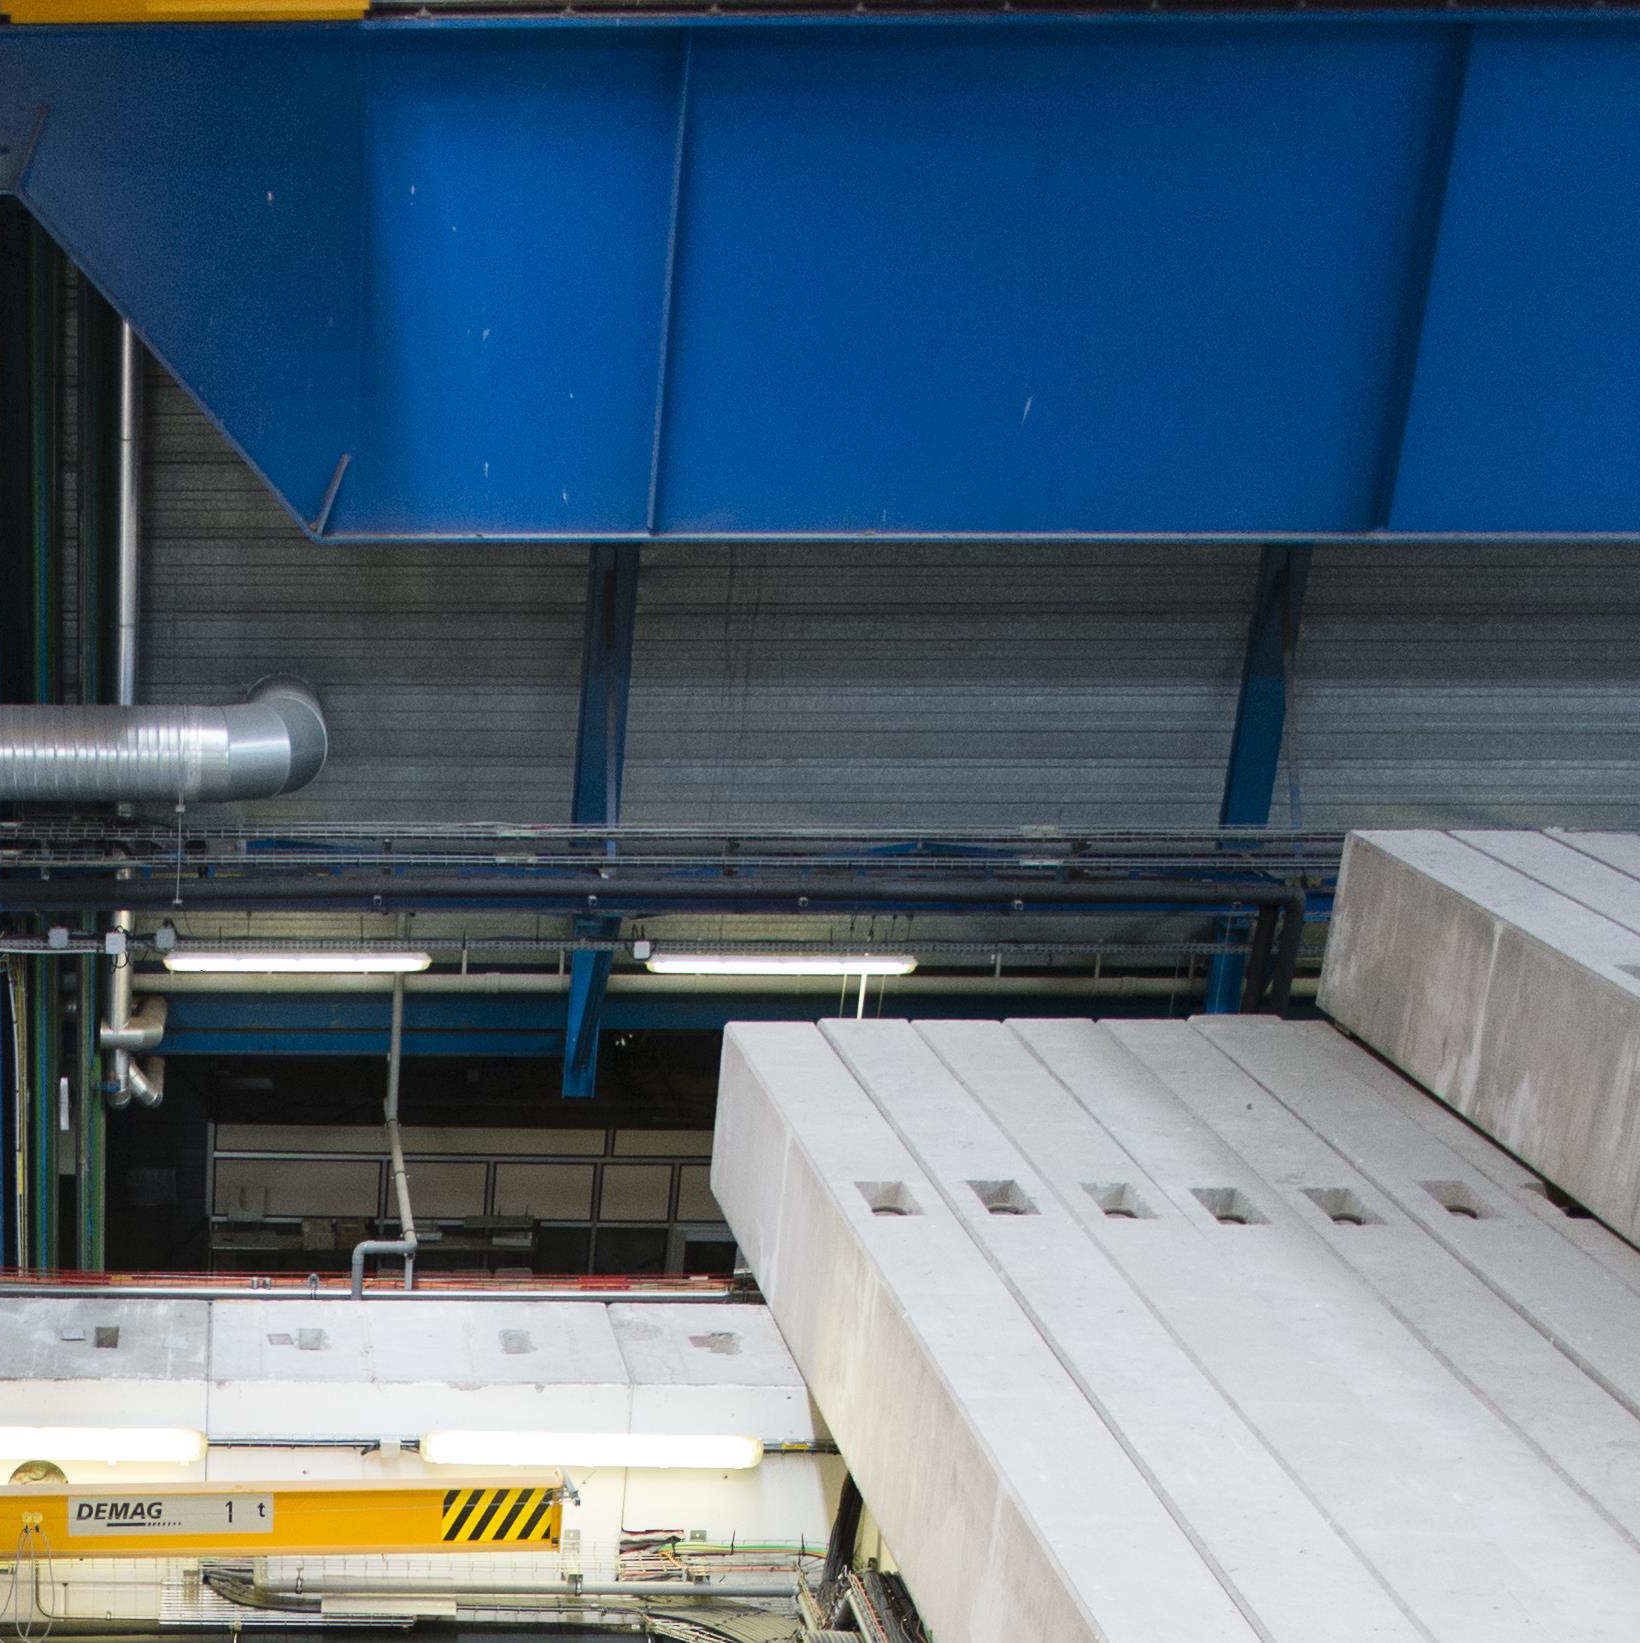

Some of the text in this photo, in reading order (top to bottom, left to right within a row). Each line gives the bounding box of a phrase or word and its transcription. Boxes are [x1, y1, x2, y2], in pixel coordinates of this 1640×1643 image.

[76, 1501, 266, 1523] DEMAG 1 t
